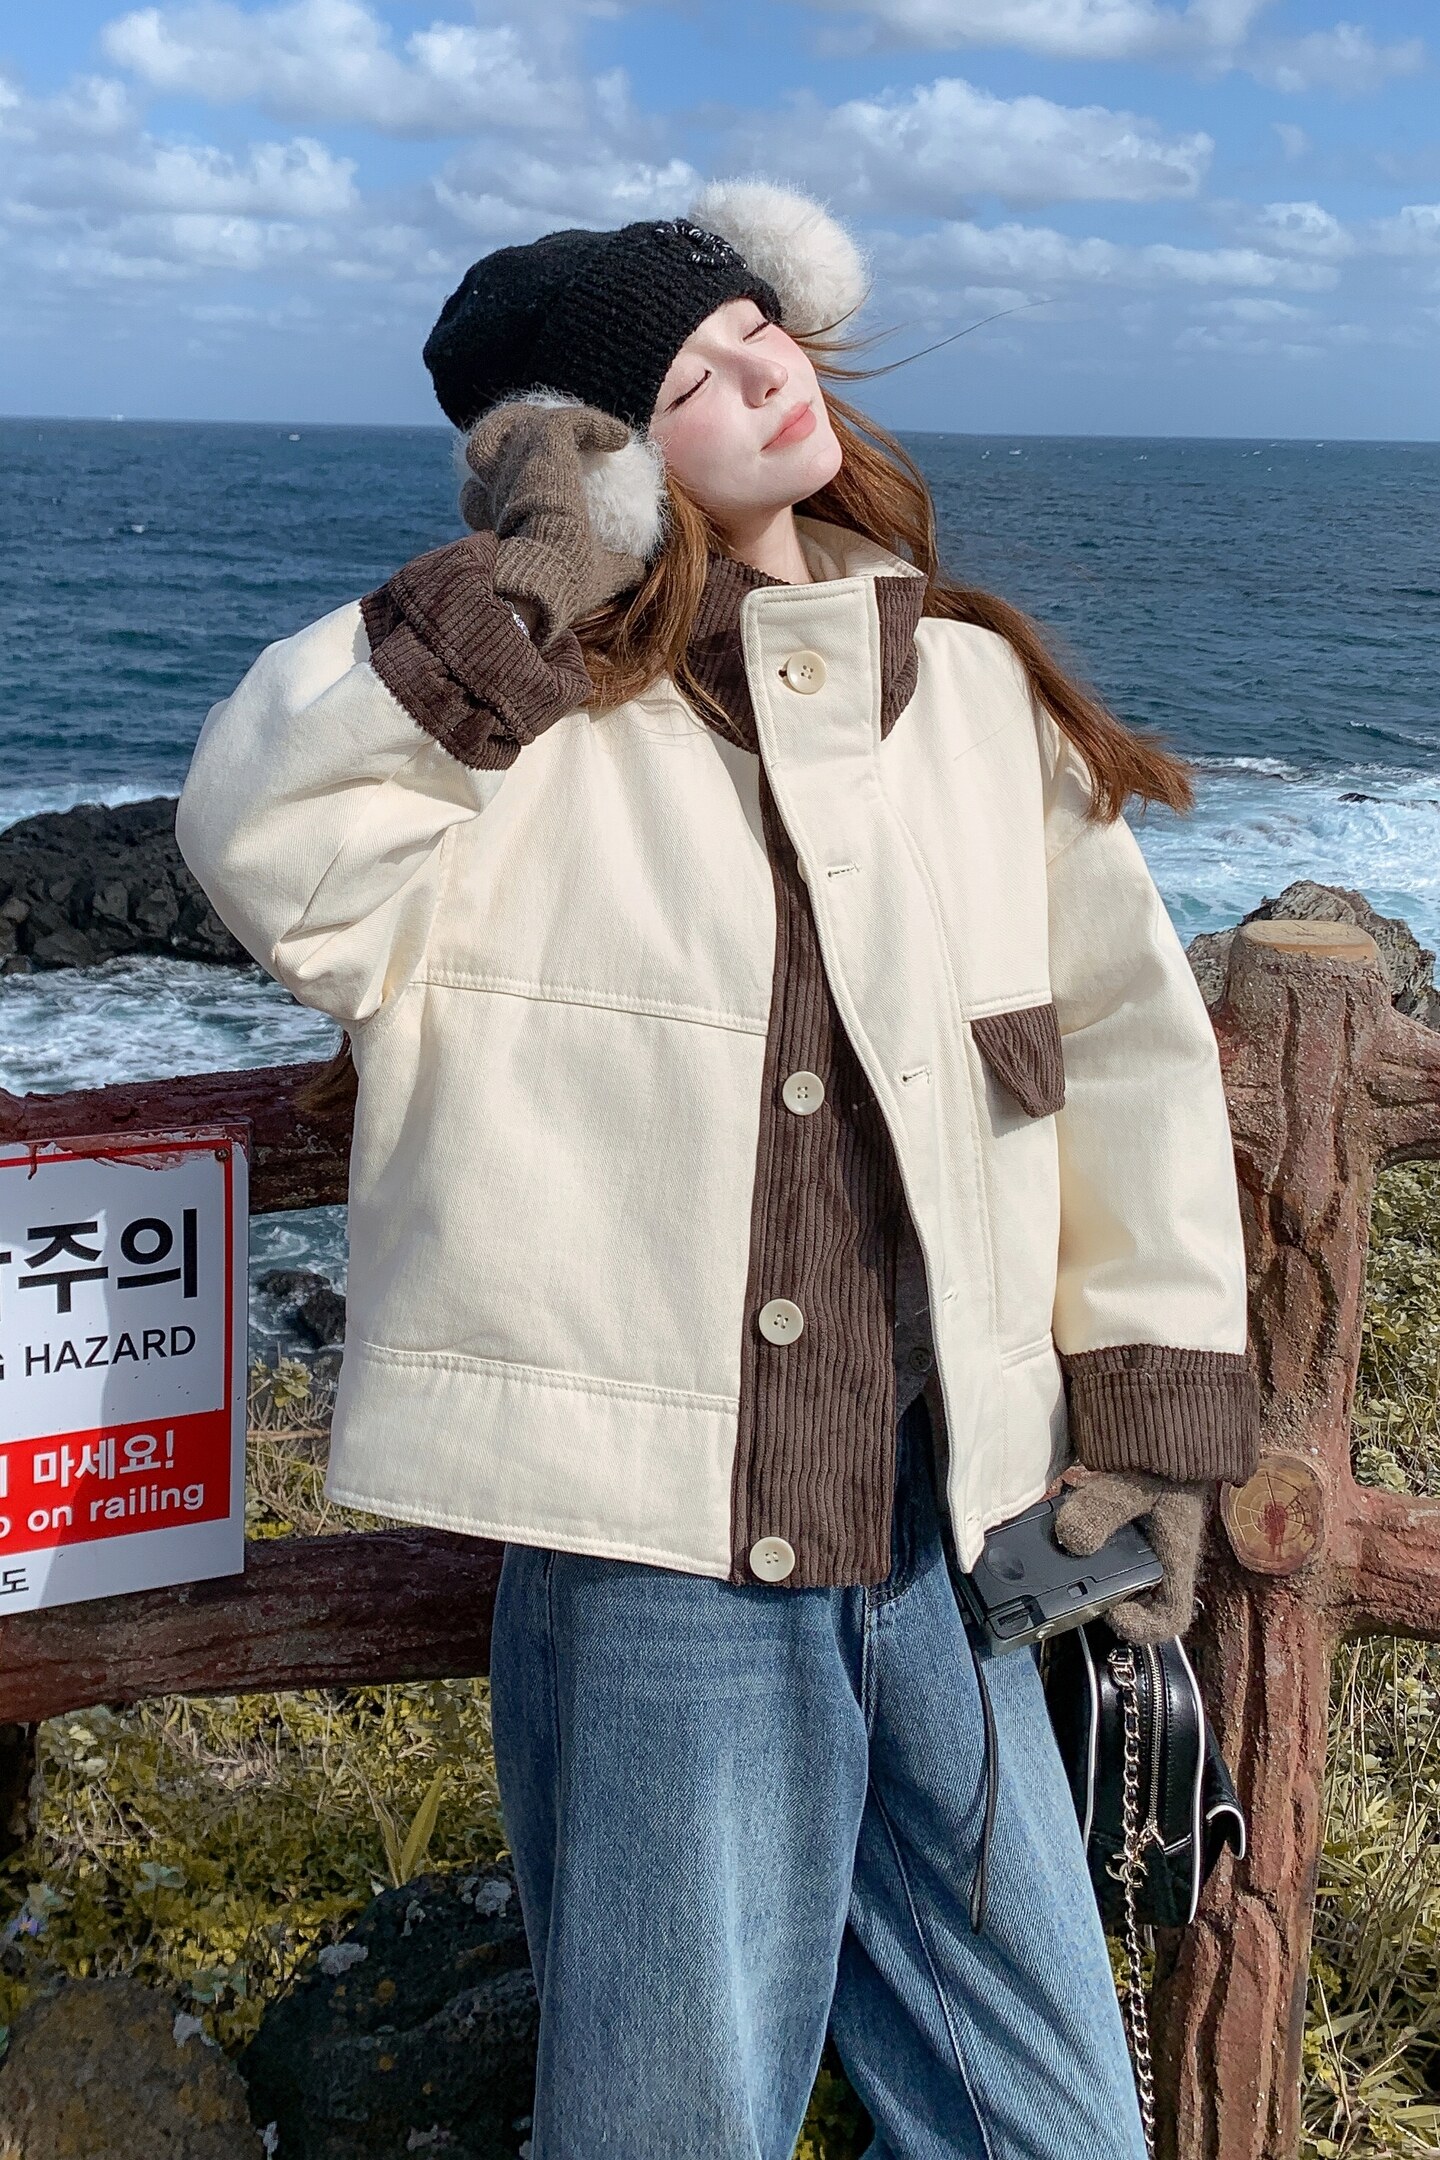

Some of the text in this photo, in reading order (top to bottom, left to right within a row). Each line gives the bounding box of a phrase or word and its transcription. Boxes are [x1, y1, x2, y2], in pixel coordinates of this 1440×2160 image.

[0, 1208, 197, 1314] 주의
[25, 1325, 196, 1377] HAZARD
[33, 1430, 175, 1488] 마세요!
[27, 1505, 72, 1532] on
[90, 1483, 204, 1523] railing
